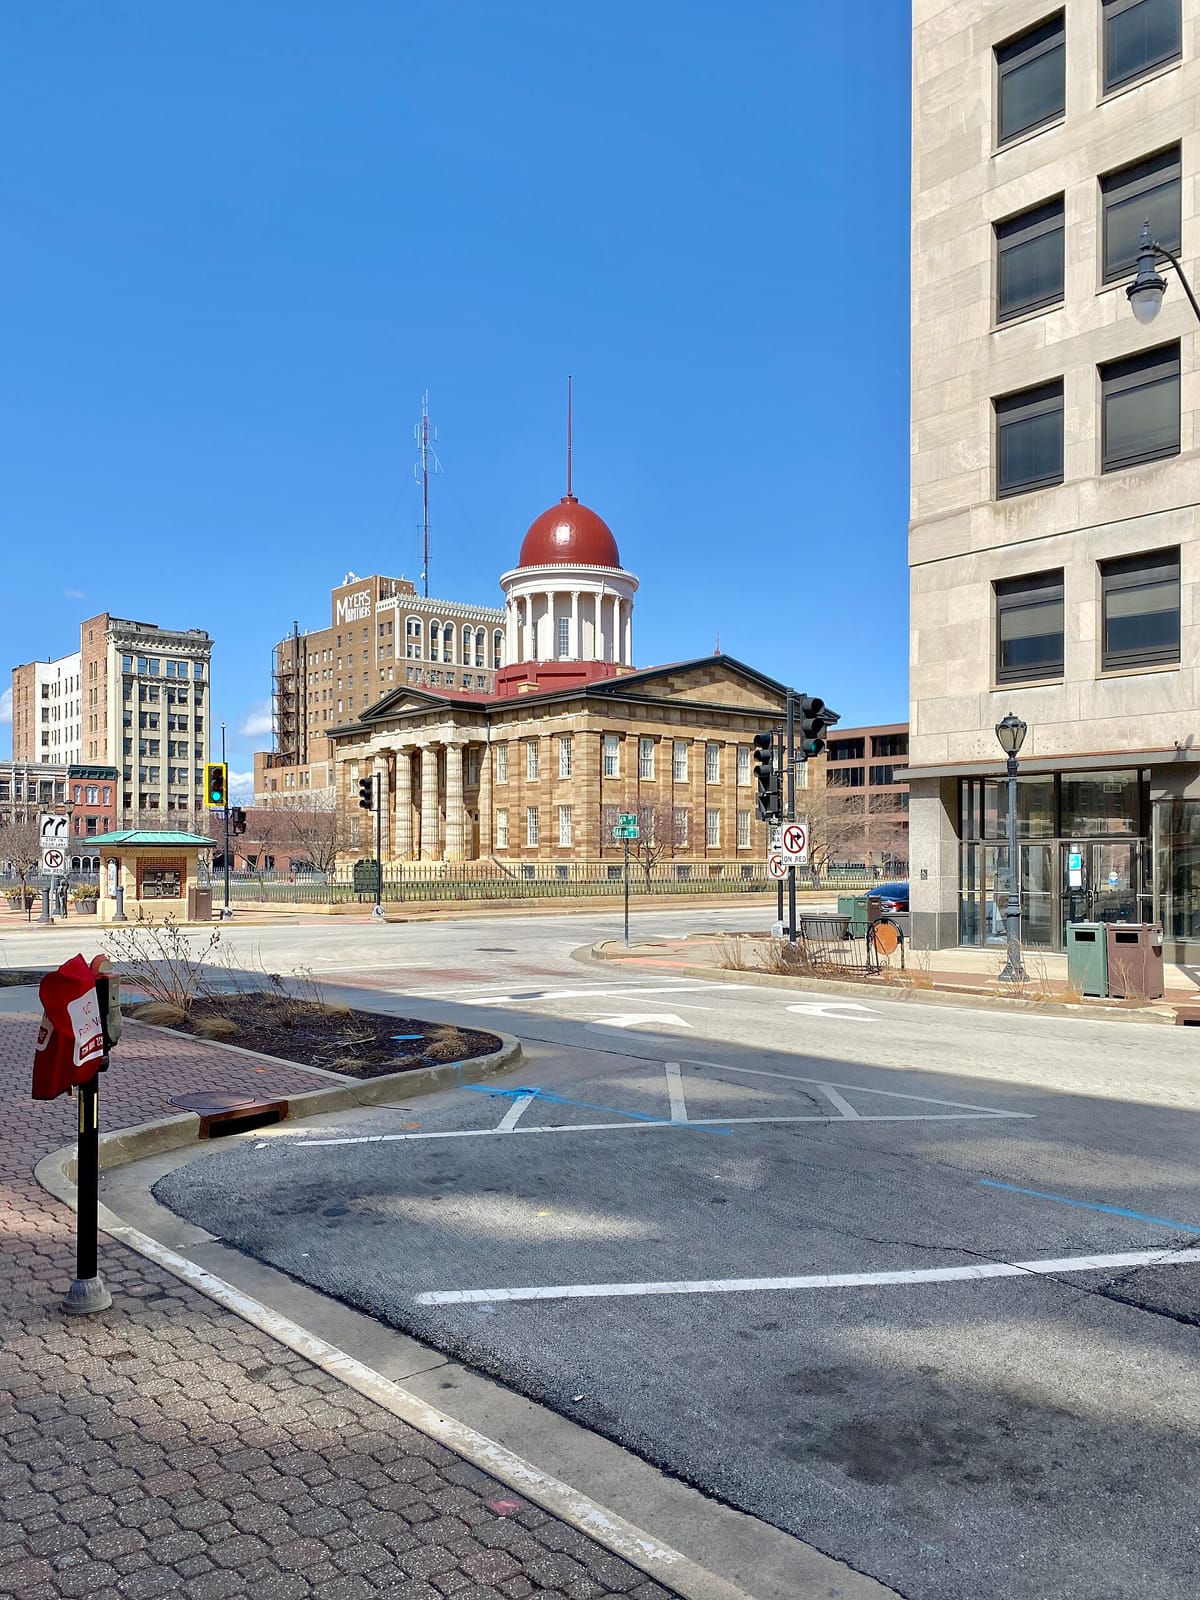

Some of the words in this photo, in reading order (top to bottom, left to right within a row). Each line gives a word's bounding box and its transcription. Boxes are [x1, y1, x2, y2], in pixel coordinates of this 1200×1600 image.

[336, 589, 371, 626] MYERS
[784, 855, 793, 863] ON
[794, 855, 807, 863] RED
[82, 1001, 92, 1016] NO
